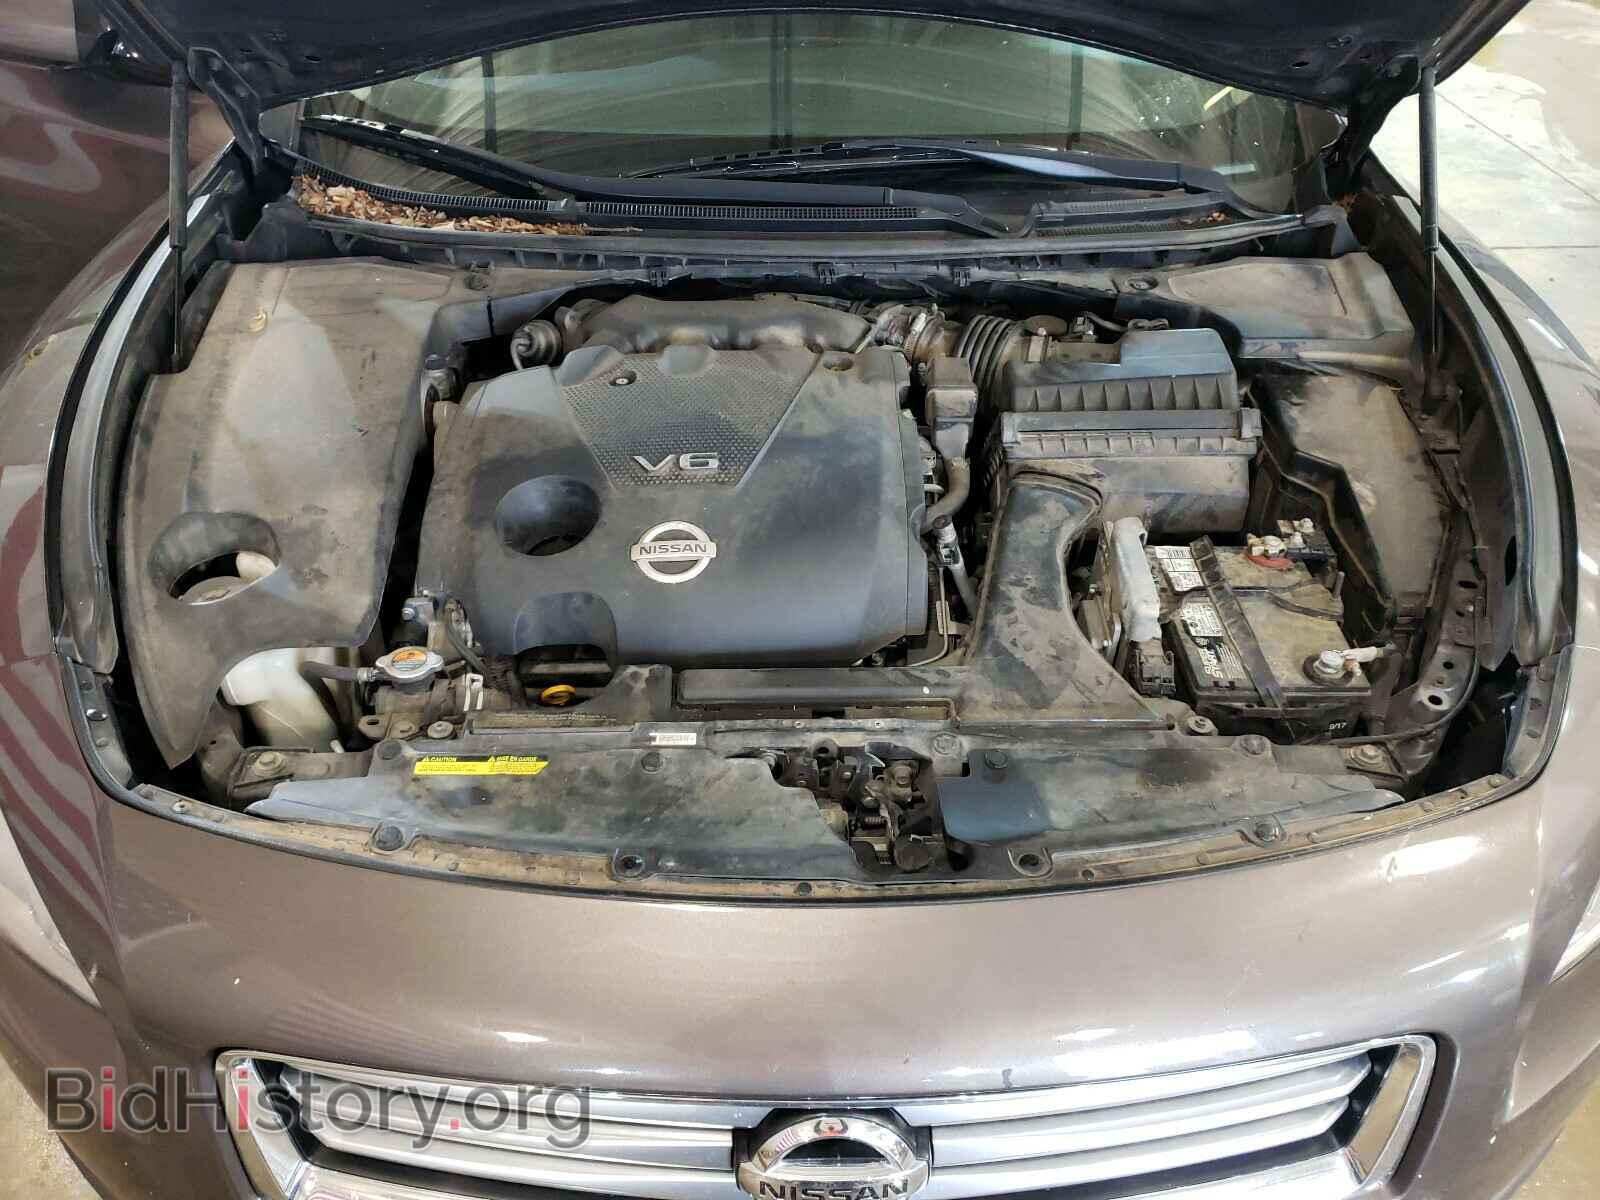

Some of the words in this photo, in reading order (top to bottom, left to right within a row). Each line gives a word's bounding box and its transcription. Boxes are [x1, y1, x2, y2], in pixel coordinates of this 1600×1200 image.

[633, 453, 719, 470] V6
[639, 544, 707, 555] NISSAN
[759, 1179, 908, 1200] NISSAN
